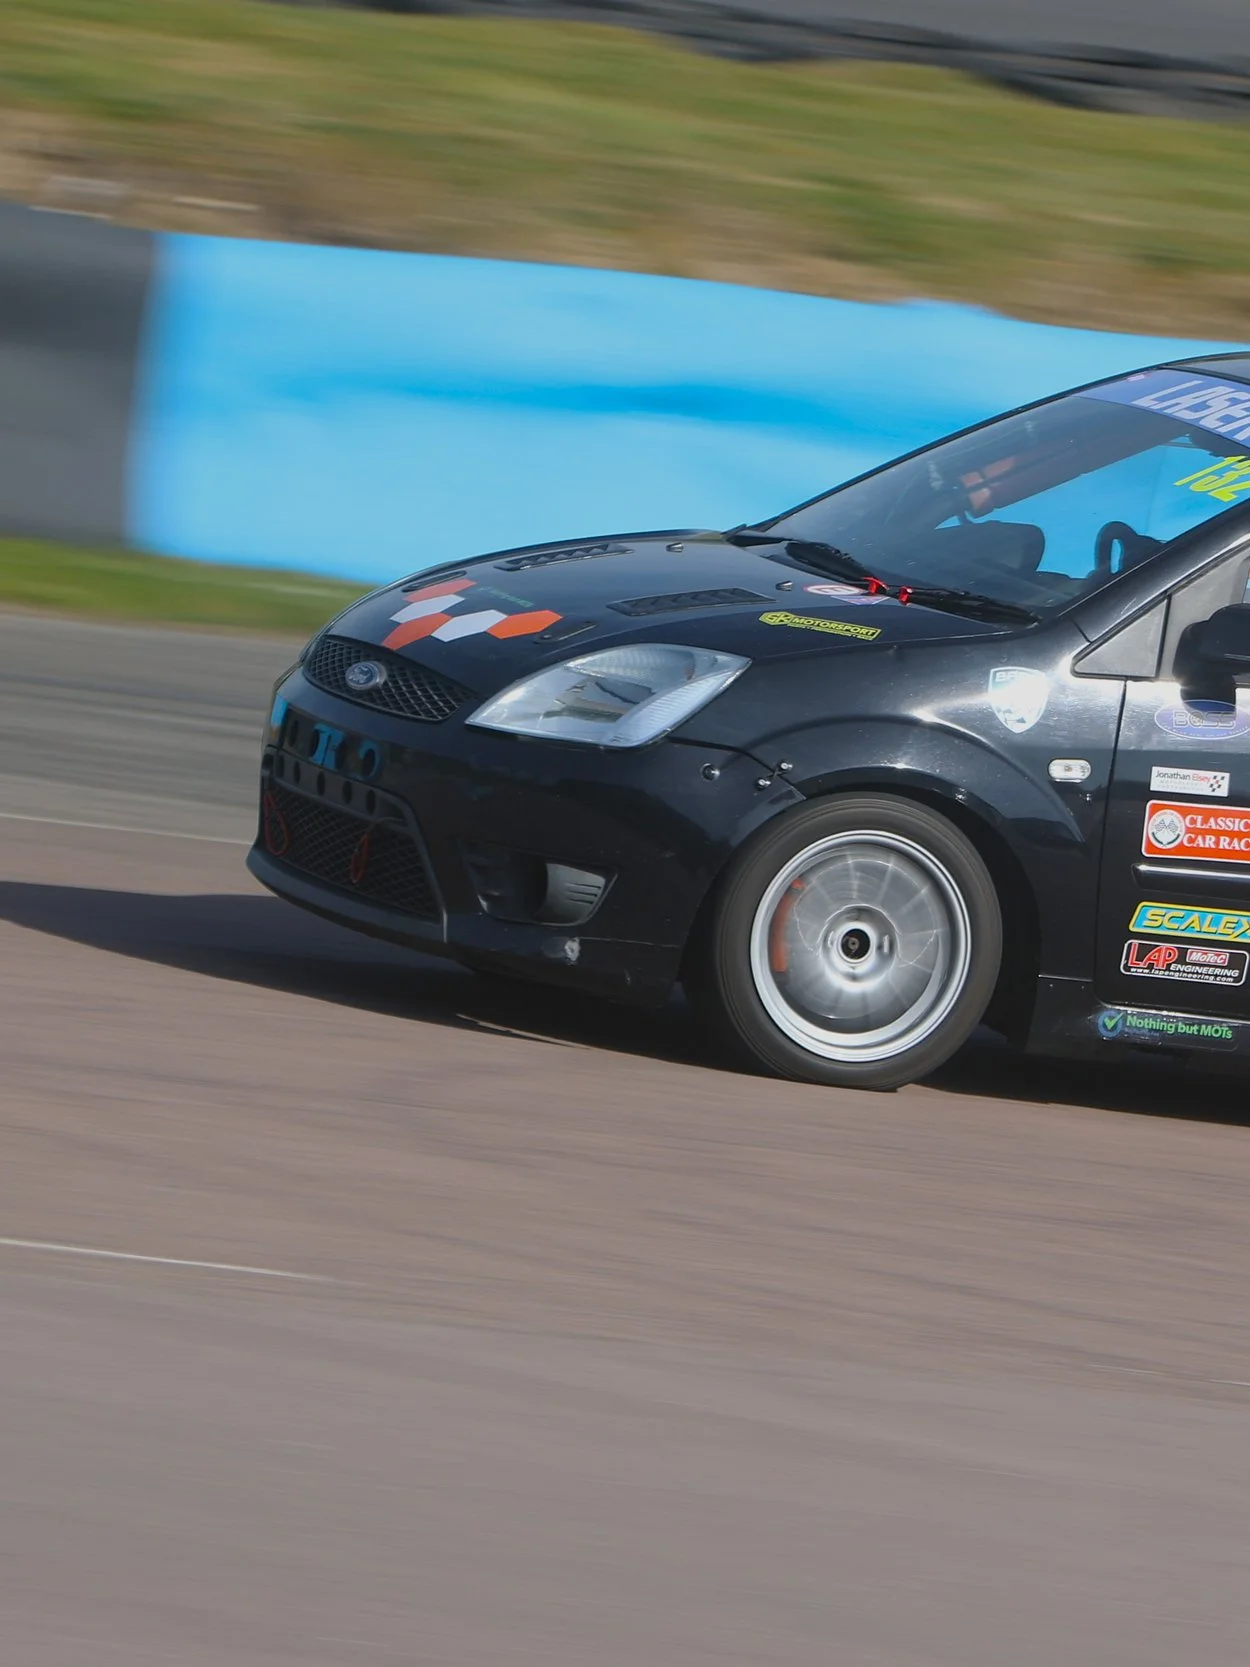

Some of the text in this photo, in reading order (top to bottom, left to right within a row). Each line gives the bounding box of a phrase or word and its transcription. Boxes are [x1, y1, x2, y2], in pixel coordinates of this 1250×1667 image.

[791, 617, 877, 636] MOTORSPORT
[1155, 770, 1191, 781] Jonathan
[1185, 814, 1250, 833] CLASSIC
[1182, 833, 1217, 848] CAR
[1128, 942, 1179, 970] LAP
[1188, 951, 1227, 964] MoTeC
[1130, 967, 1234, 983] www.lapengineering.com
[1170, 964, 1240, 978] ENGINEERING
[1126, 1015, 1176, 1034] Nothing
[1178, 1021, 1199, 1035] but
[1200, 1024, 1233, 1039] MOTs
